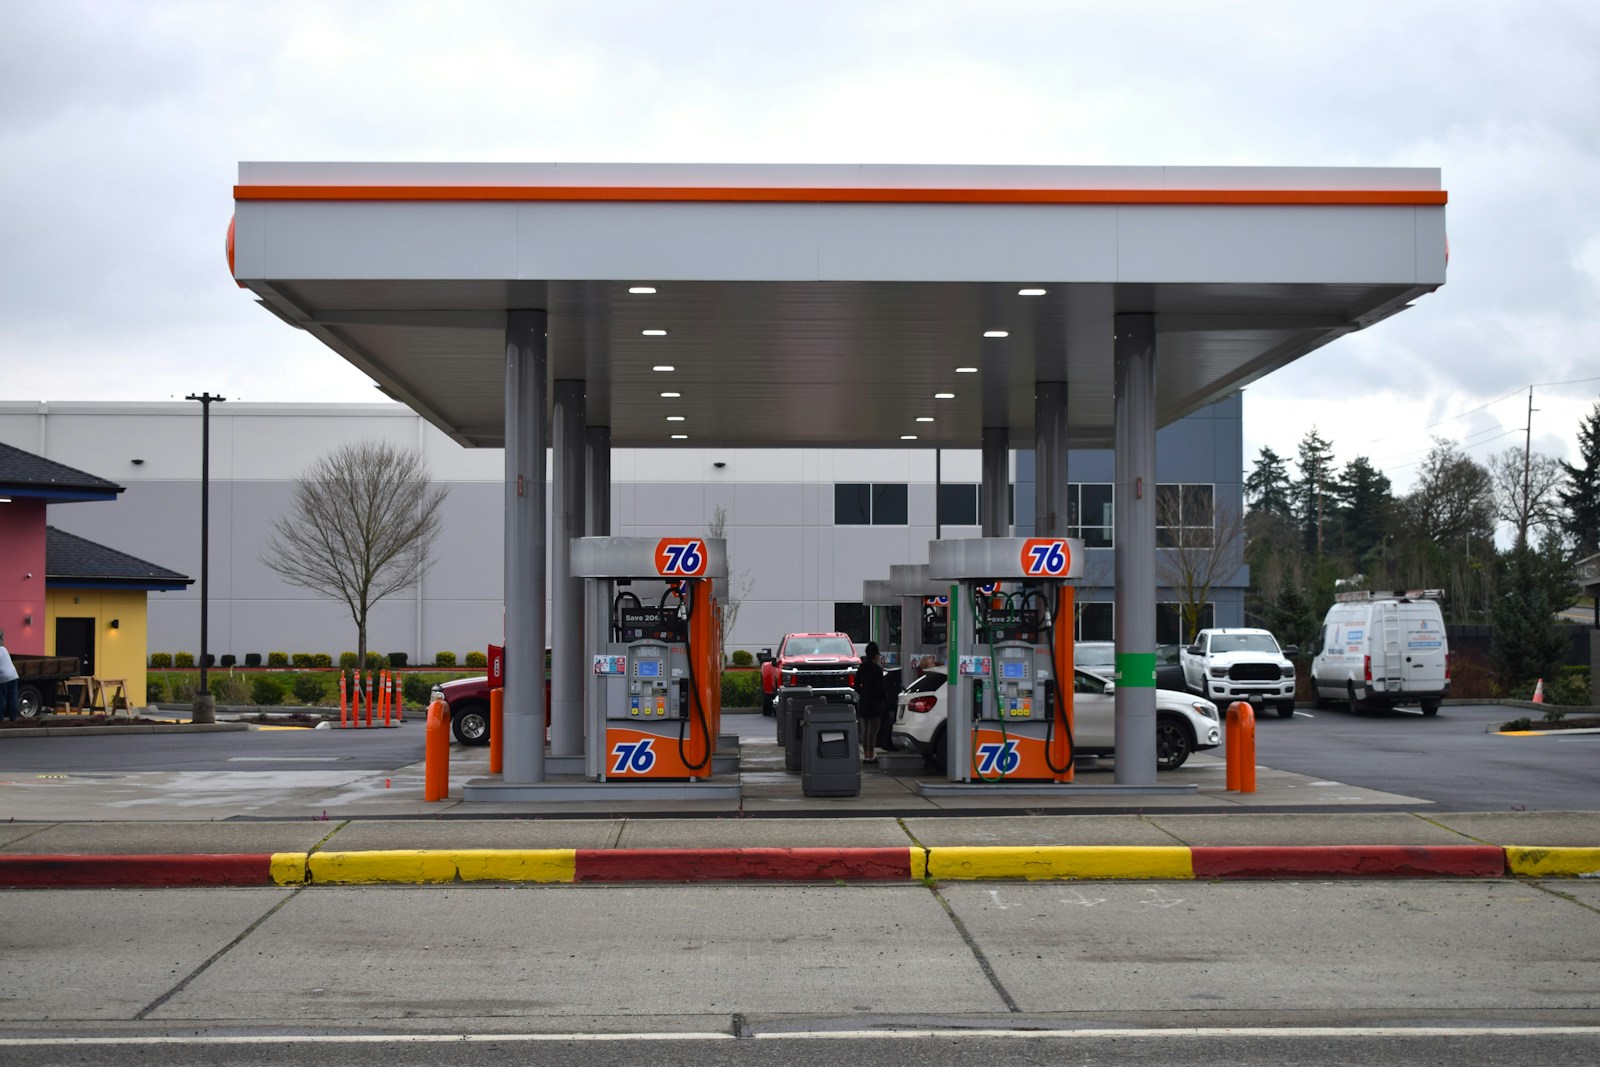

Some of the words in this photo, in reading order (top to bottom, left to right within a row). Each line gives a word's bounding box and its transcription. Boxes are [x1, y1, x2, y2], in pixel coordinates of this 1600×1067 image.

[662, 541, 702, 574] 76
[1028, 541, 1066, 575] 76
[611, 738, 656, 774] 76
[976, 739, 1021, 774] 76
